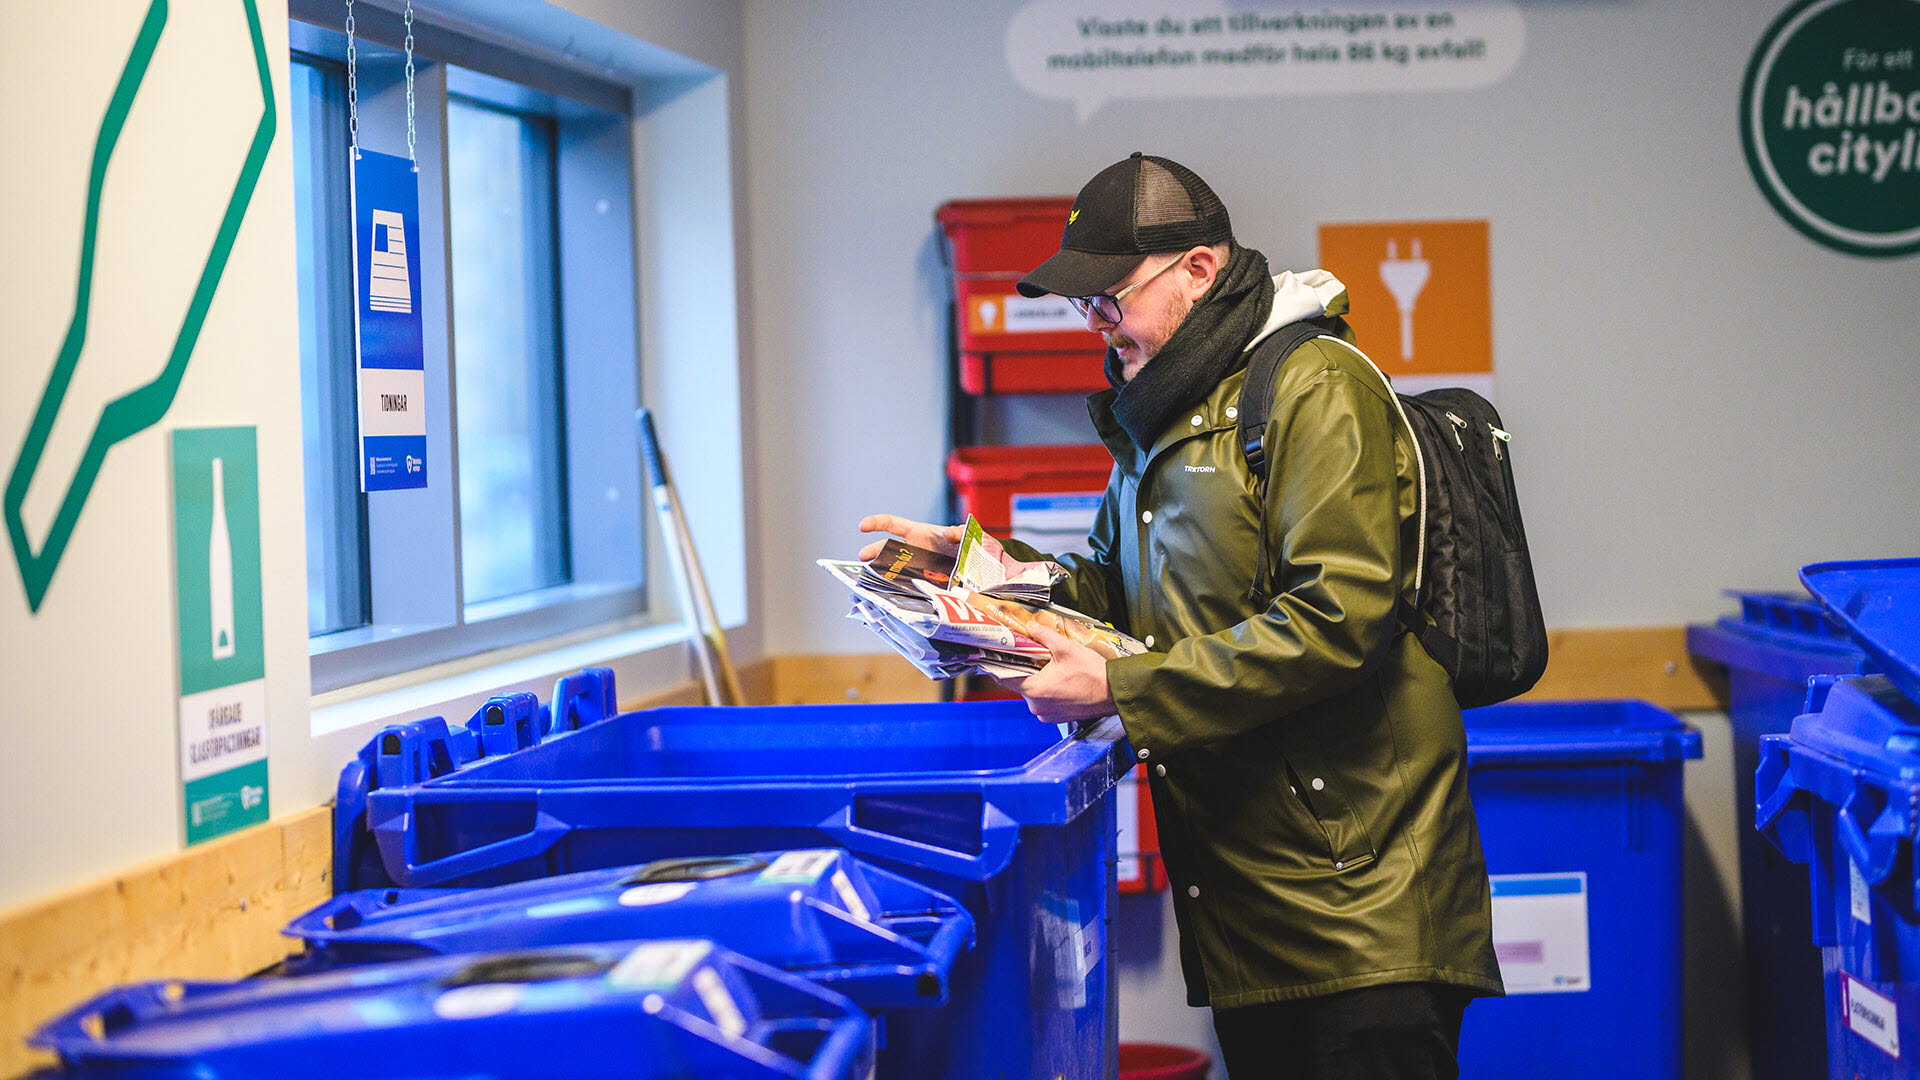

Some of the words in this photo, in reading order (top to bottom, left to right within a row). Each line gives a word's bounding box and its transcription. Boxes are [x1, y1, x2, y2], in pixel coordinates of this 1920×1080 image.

[1154, 16, 1185, 35] du
[1381, 41, 1410, 66] kg
[381, 394, 407, 412] TIDNINGAR
